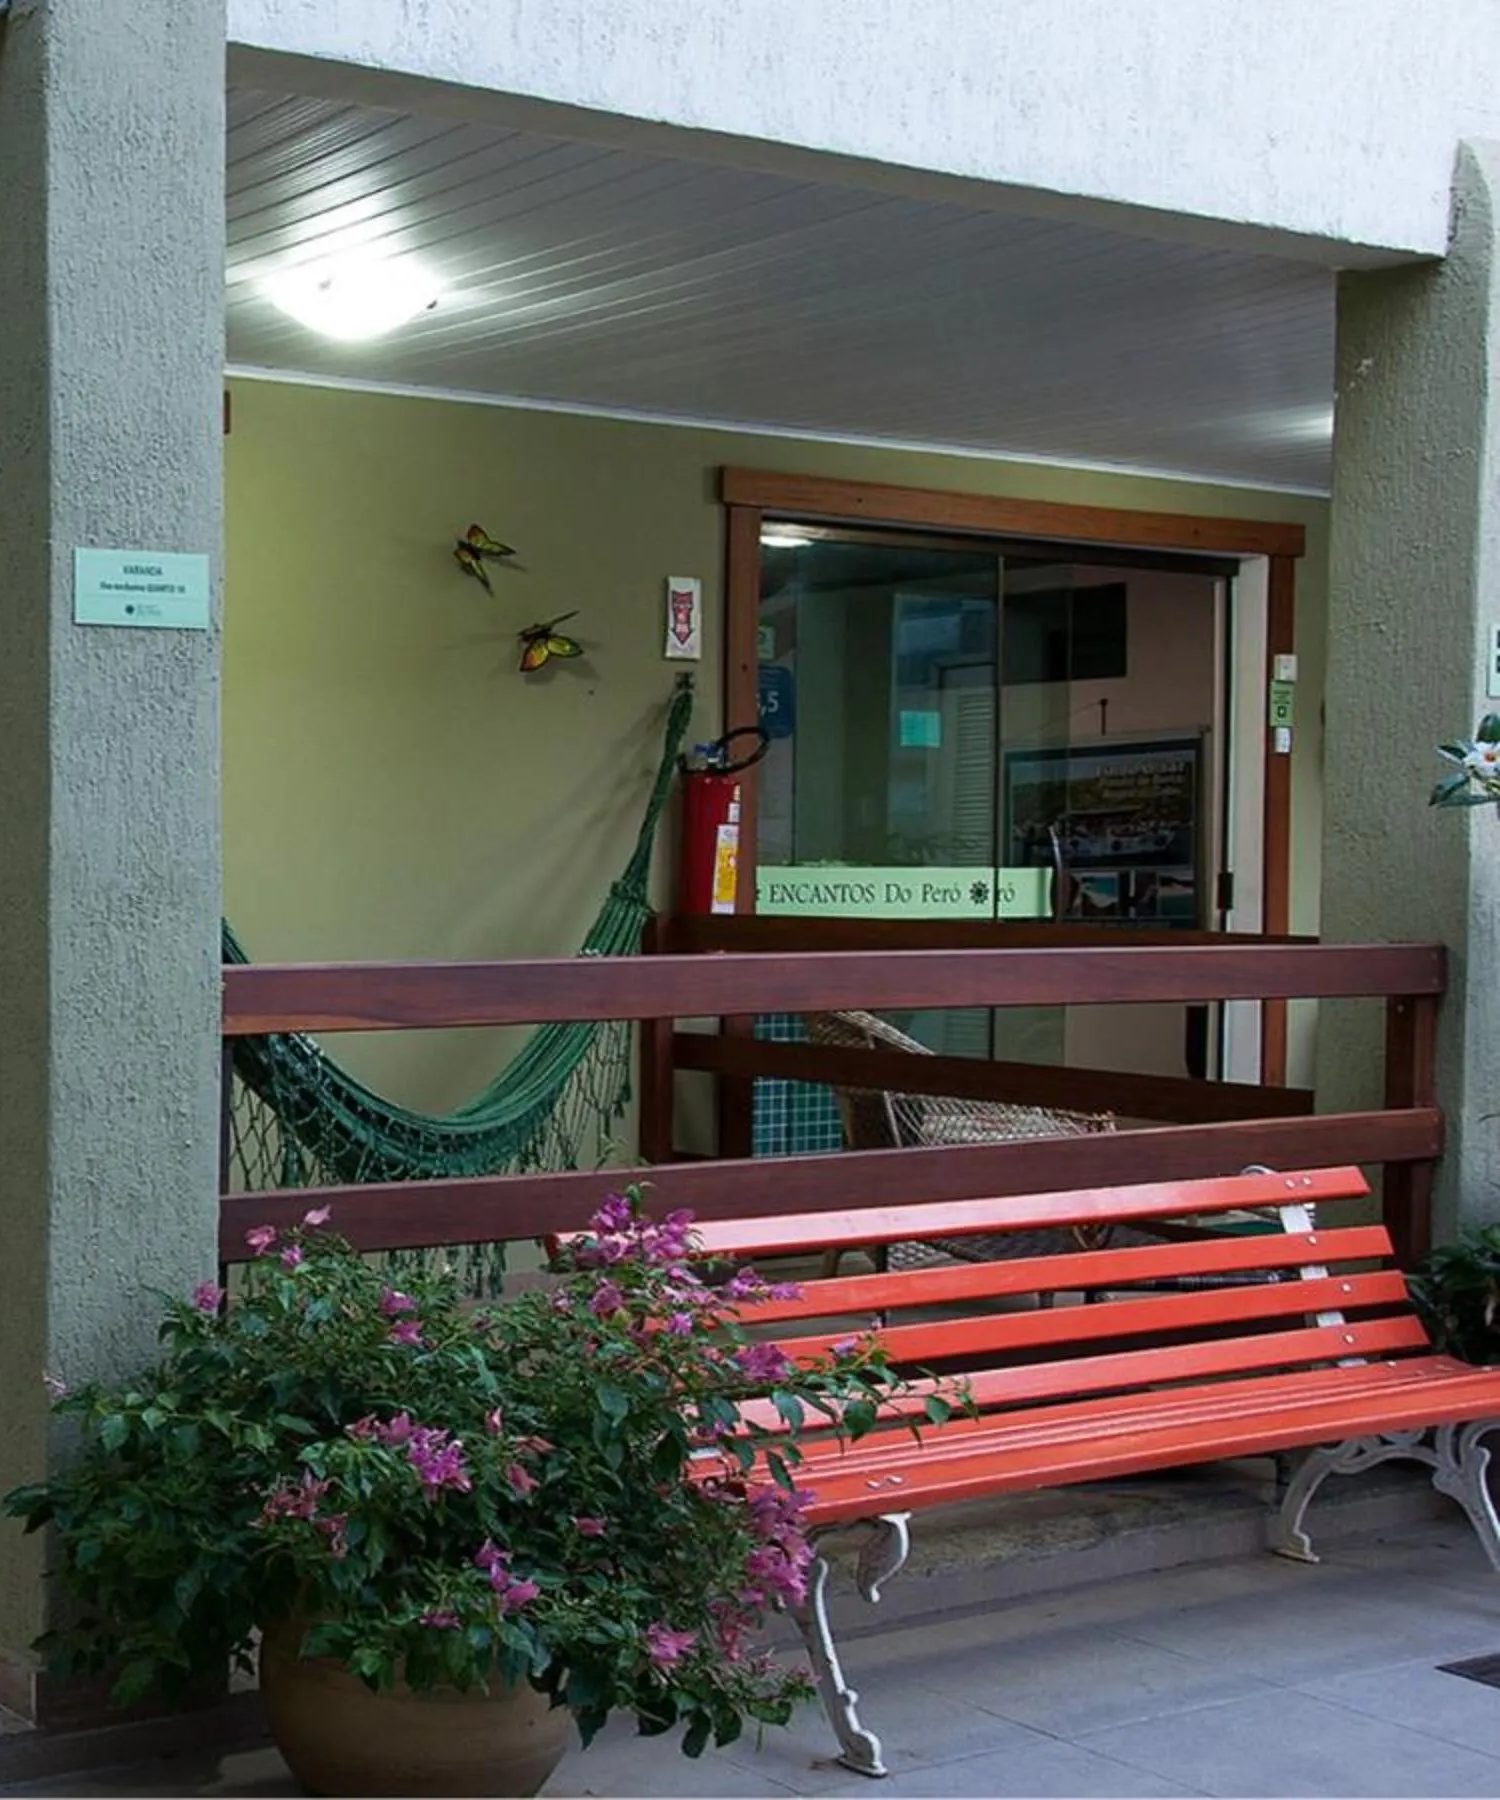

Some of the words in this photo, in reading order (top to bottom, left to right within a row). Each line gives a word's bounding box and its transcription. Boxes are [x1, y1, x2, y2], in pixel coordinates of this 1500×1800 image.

[756, 690, 779, 717] ,5
[769, 883, 876, 904] ENCANTOS
[884, 883, 912, 904] Do
[921, 881, 962, 903] Peró
